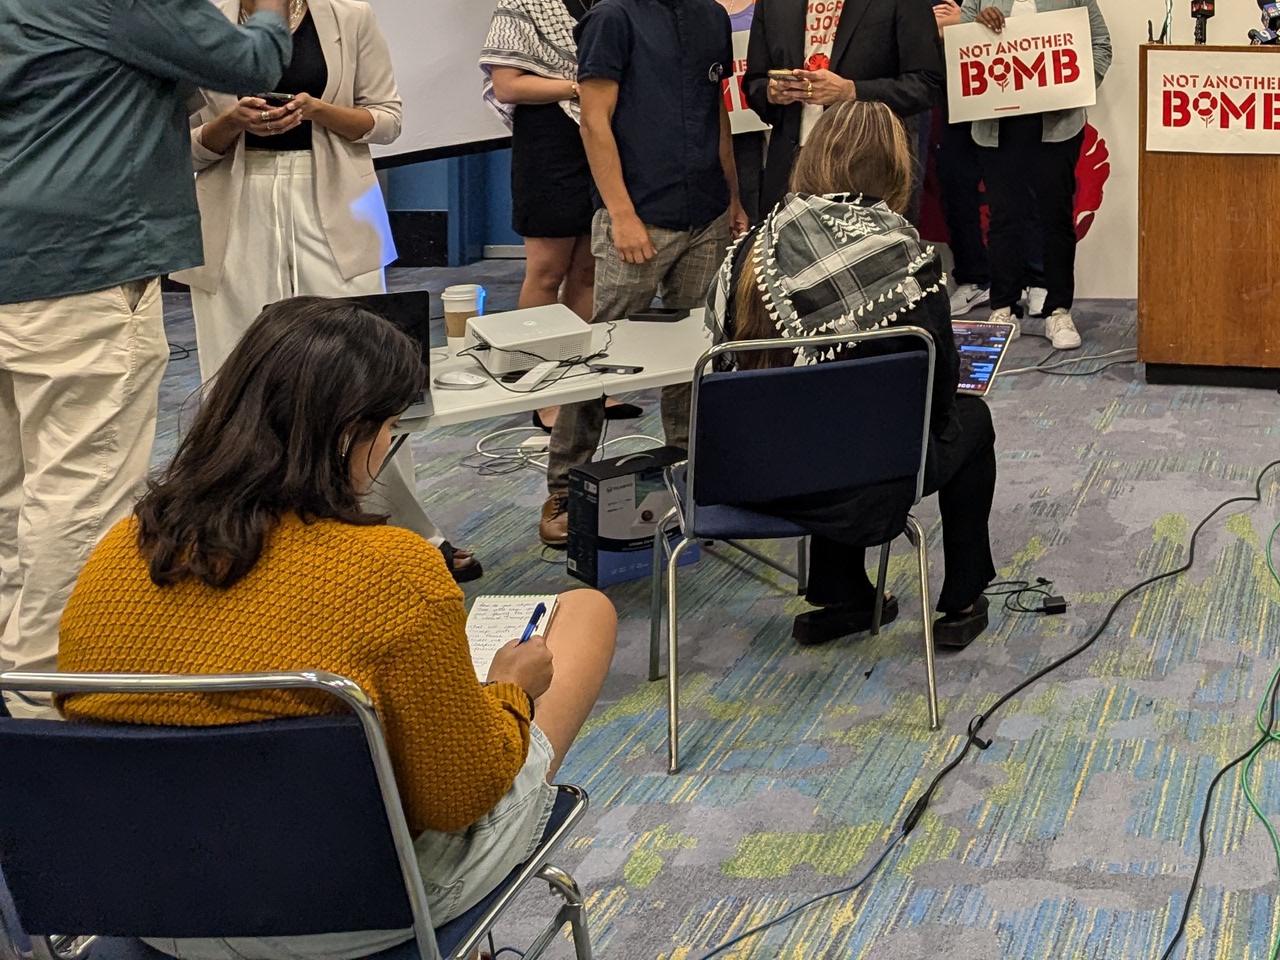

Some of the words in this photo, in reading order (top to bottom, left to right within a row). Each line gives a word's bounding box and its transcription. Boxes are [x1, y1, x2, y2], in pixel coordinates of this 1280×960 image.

[959, 43, 992, 60] NOT
[995, 32, 1074, 55] ANOTHER
[960, 48, 1080, 97] BOMB
[1163, 74, 1199, 88] NOT
